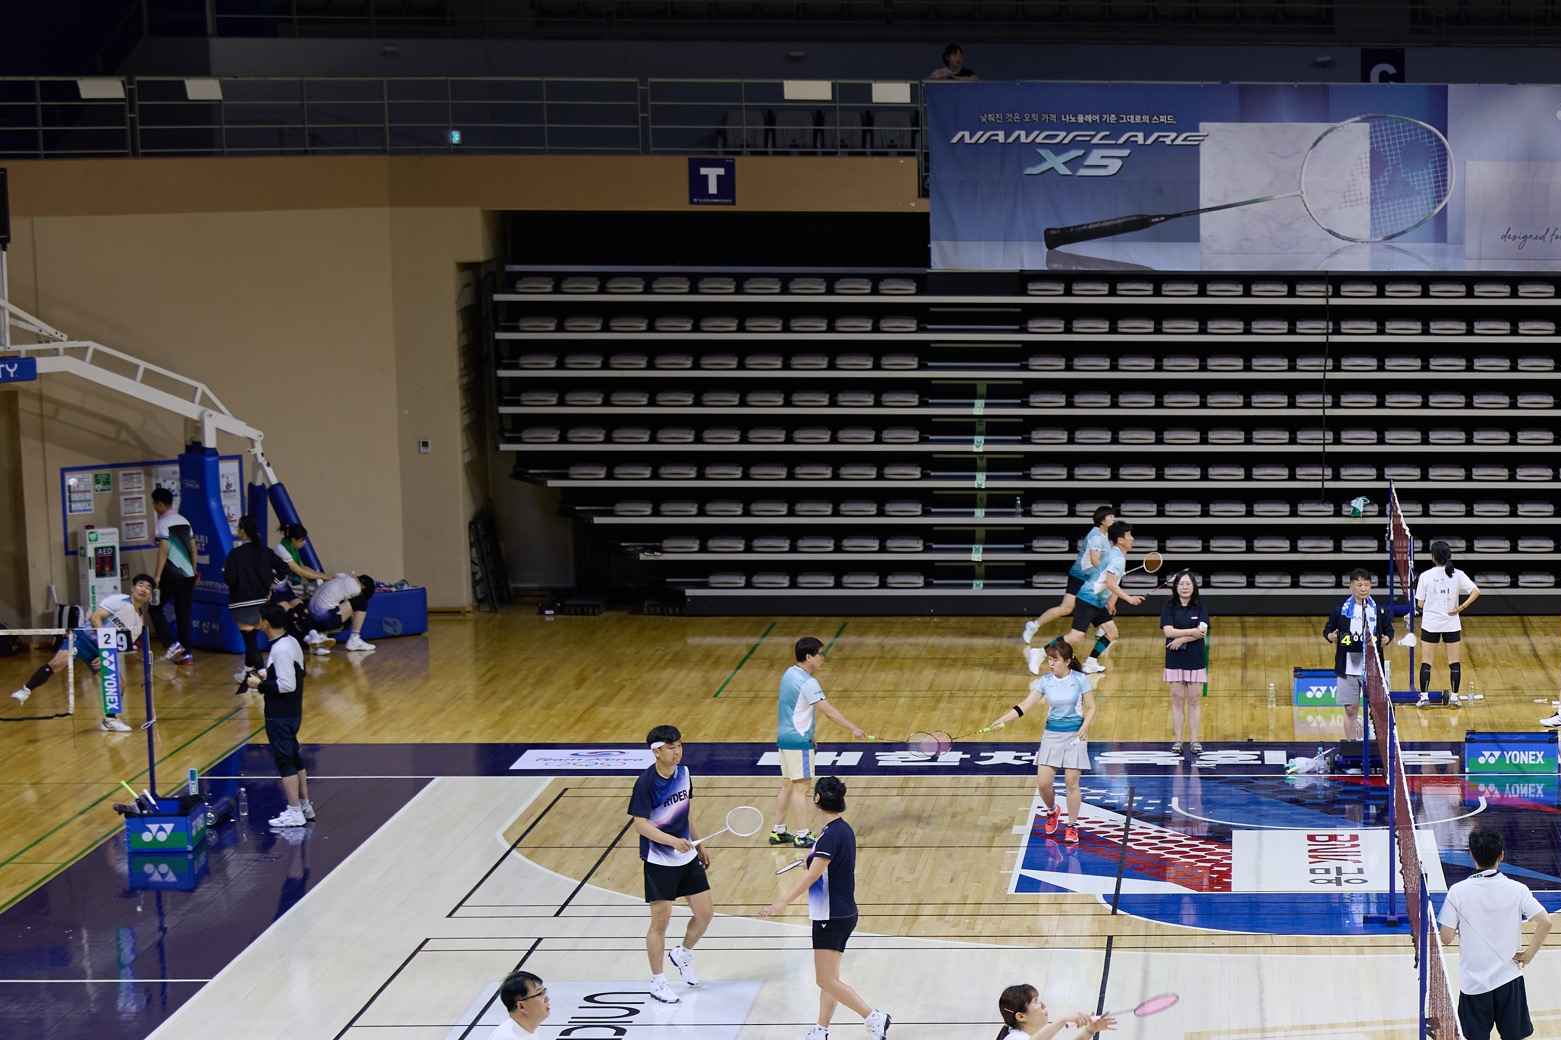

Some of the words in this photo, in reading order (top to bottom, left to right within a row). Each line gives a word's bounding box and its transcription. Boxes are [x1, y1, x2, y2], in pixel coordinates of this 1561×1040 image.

[951, 130, 1209, 145] NANOFLARE
[1024, 148, 1132, 177] X5
[700, 167, 725, 194] T
[103, 633, 111, 644] 2
[117, 632, 128, 651] 9
[103, 673, 119, 710] YONEX
[1503, 751, 1545, 765] YONEX
[1306, 833, 1363, 865] BNK
[1309, 866, 1368, 887] 금융
